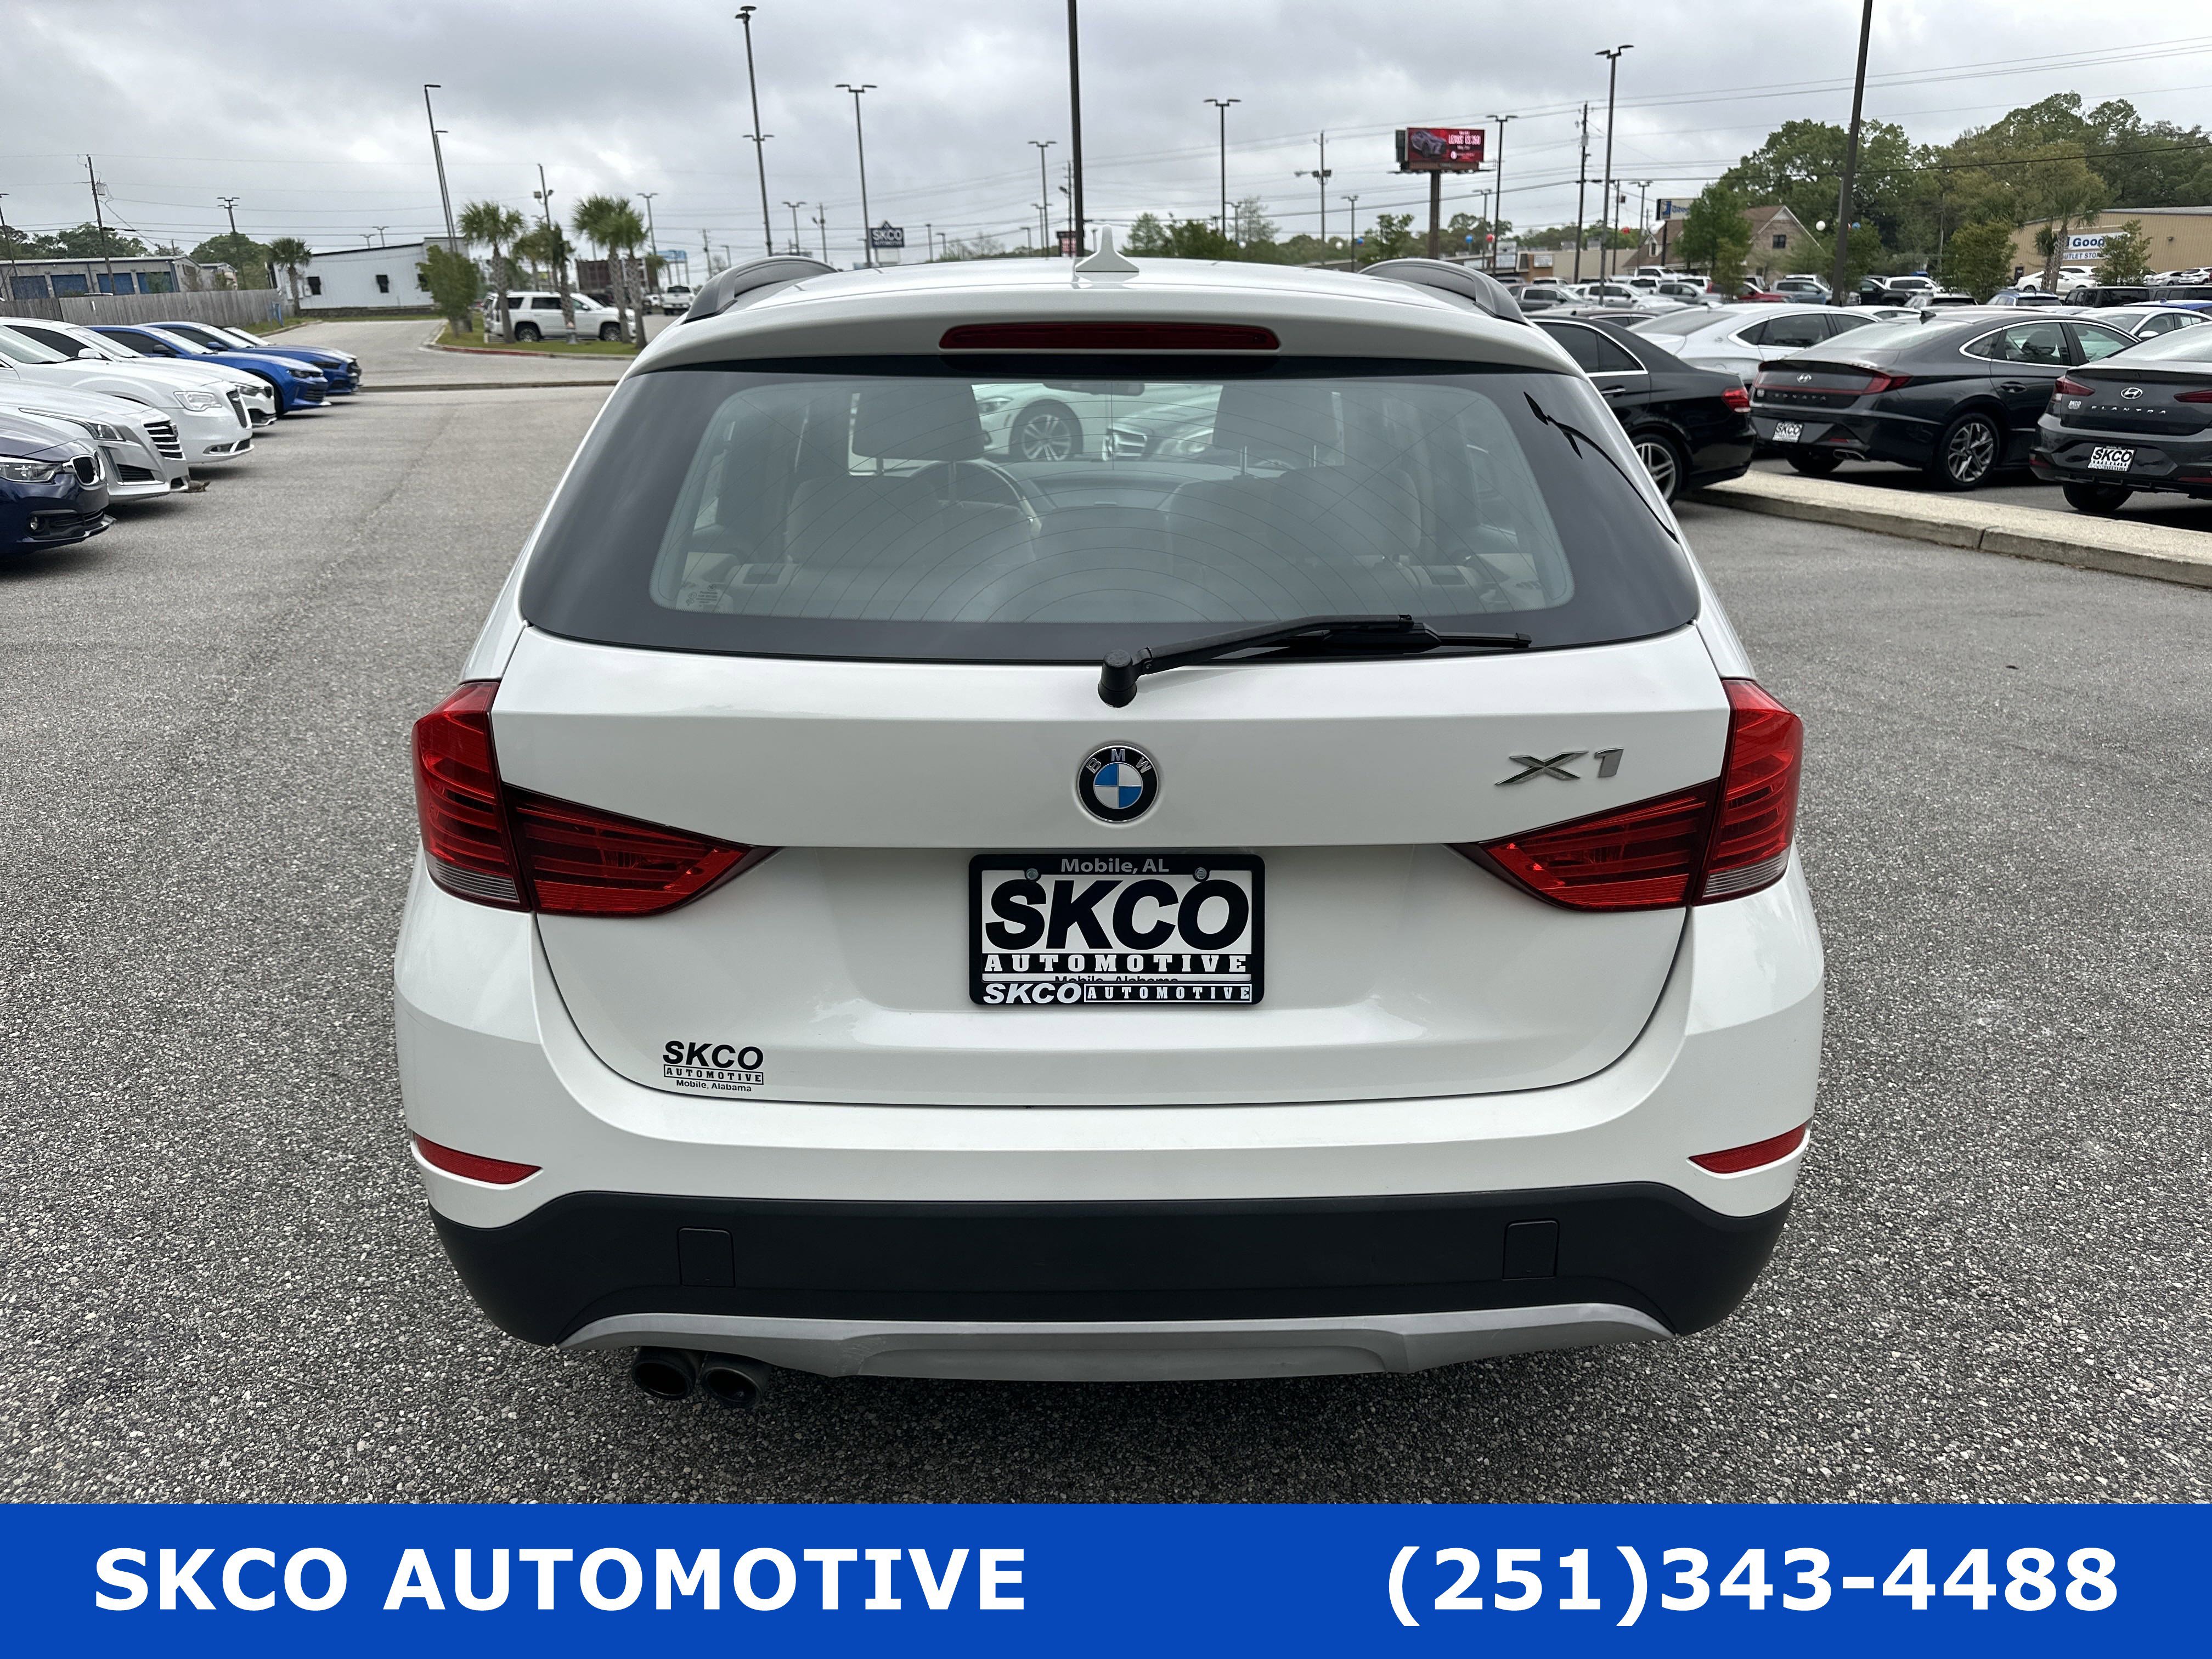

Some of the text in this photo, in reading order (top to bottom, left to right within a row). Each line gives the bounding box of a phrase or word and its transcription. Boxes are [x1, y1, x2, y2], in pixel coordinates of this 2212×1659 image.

[872, 229, 902, 241] SKCO
[2093, 449, 2132, 462] SKCO
[1086, 748, 1152, 774] BMW
[1494, 747, 1624, 785] X1
[1061, 858, 1169, 874] Mobile, AL
[985, 879, 1249, 950] SKCO
[985, 954, 1246, 972] AUTOMOTIVE
[983, 983, 1249, 1003] SKCO AUTOMOTIVE
[663, 1040, 764, 1070] SKCO
[667, 1067, 761, 1082] AUTOMOTIVE
[676, 1080, 752, 1092] Mobile, Alabama
